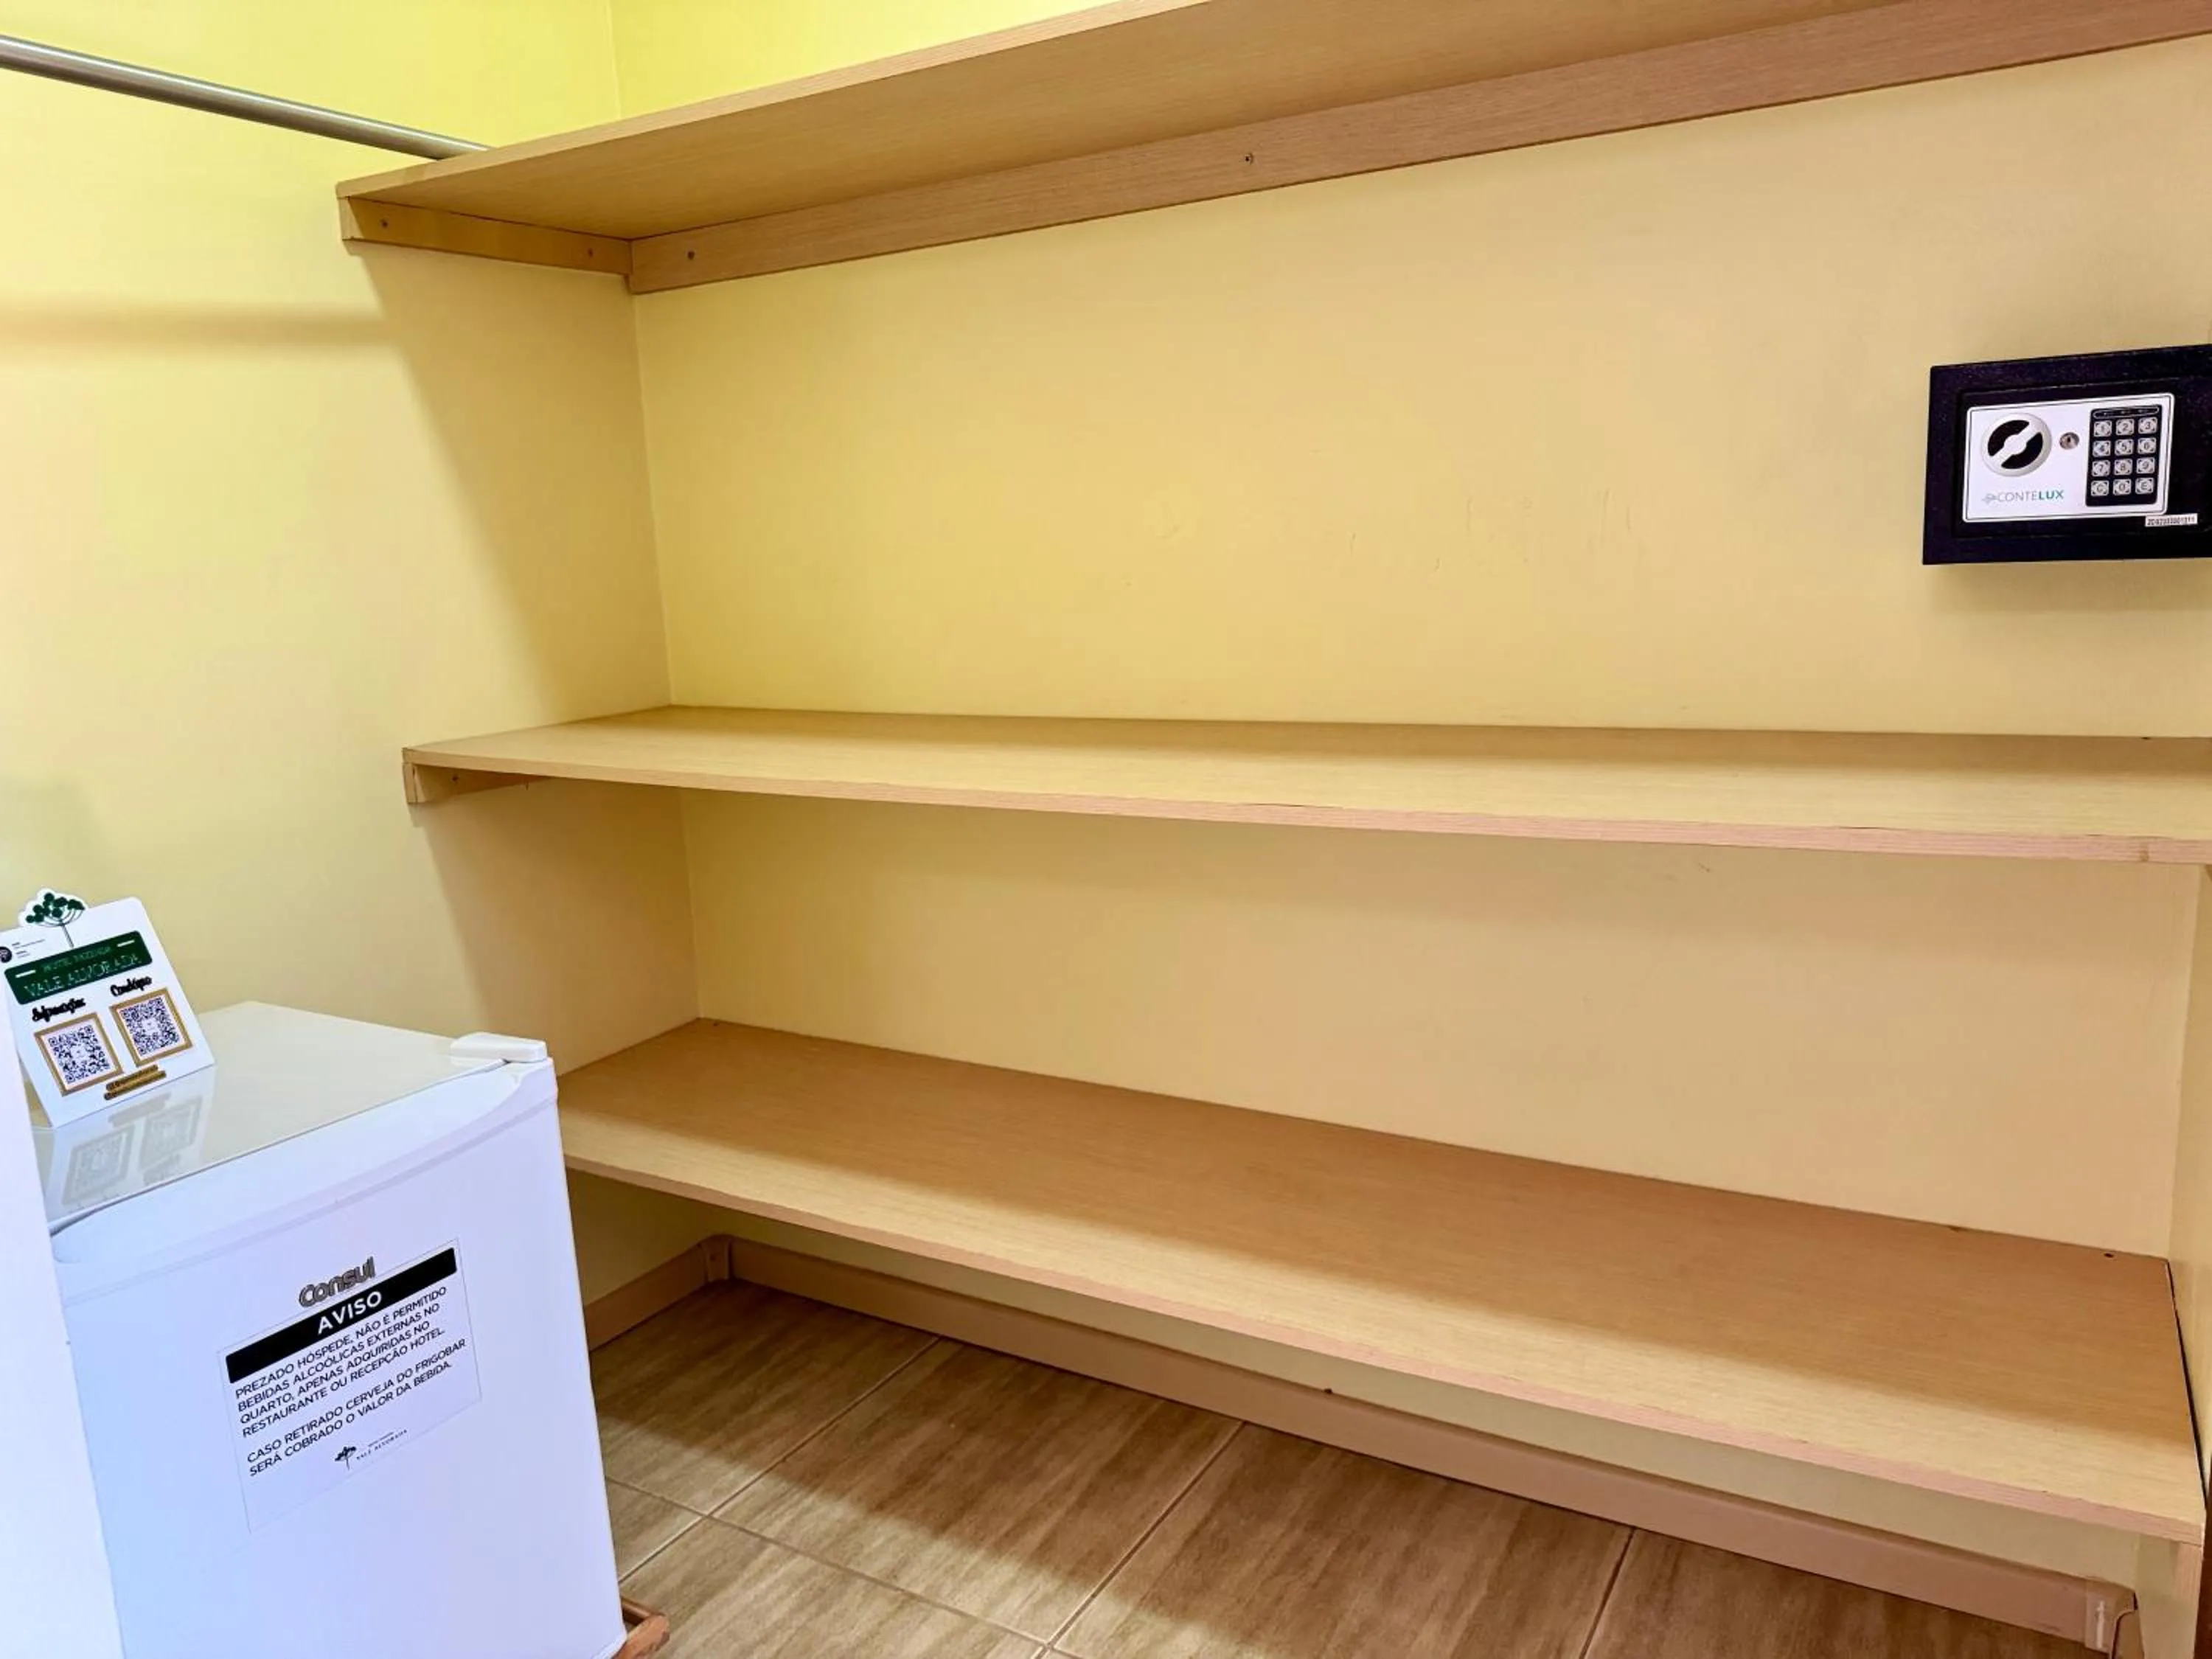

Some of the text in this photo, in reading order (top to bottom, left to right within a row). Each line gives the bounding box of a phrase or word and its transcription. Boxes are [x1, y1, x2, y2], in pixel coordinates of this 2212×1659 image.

[1997, 489, 2065, 503] CONTELUX
[299, 1256, 375, 1307] Consul
[318, 1290, 382, 1335] AVISO
[235, 1363, 294, 1399] PREZADO
[355, 1320, 381, 1339] NÃO
[383, 1313, 391, 1325] É
[392, 1286, 447, 1320] PERMITIDO
[238, 1379, 290, 1412] BEBIDAS
[366, 1312, 422, 1346] EXTERNAS
[424, 1302, 440, 1317] NO
[297, 1366, 344, 1396] APENAS
[346, 1329, 412, 1371] ADQUIRIDAS
[414, 1321, 431, 1335] NO
[242, 1387, 327, 1438] RESTAURANTE
[330, 1377, 347, 1391] OU
[349, 1344, 408, 1382] RECEPÇÃO
[248, 1439, 282, 1463] CASO
[285, 1406, 344, 1443] RETIRADO
[346, 1379, 394, 1411] CERVEJA
[396, 1368, 414, 1383] DO
[415, 1338, 466, 1373] FRIGOBAR
[250, 1451, 282, 1476] SERÁ
[285, 1419, 344, 1456] COBRADO
[346, 1413, 355, 1424] O
[357, 1391, 394, 1416] VALOR
[396, 1382, 412, 1397] DA
